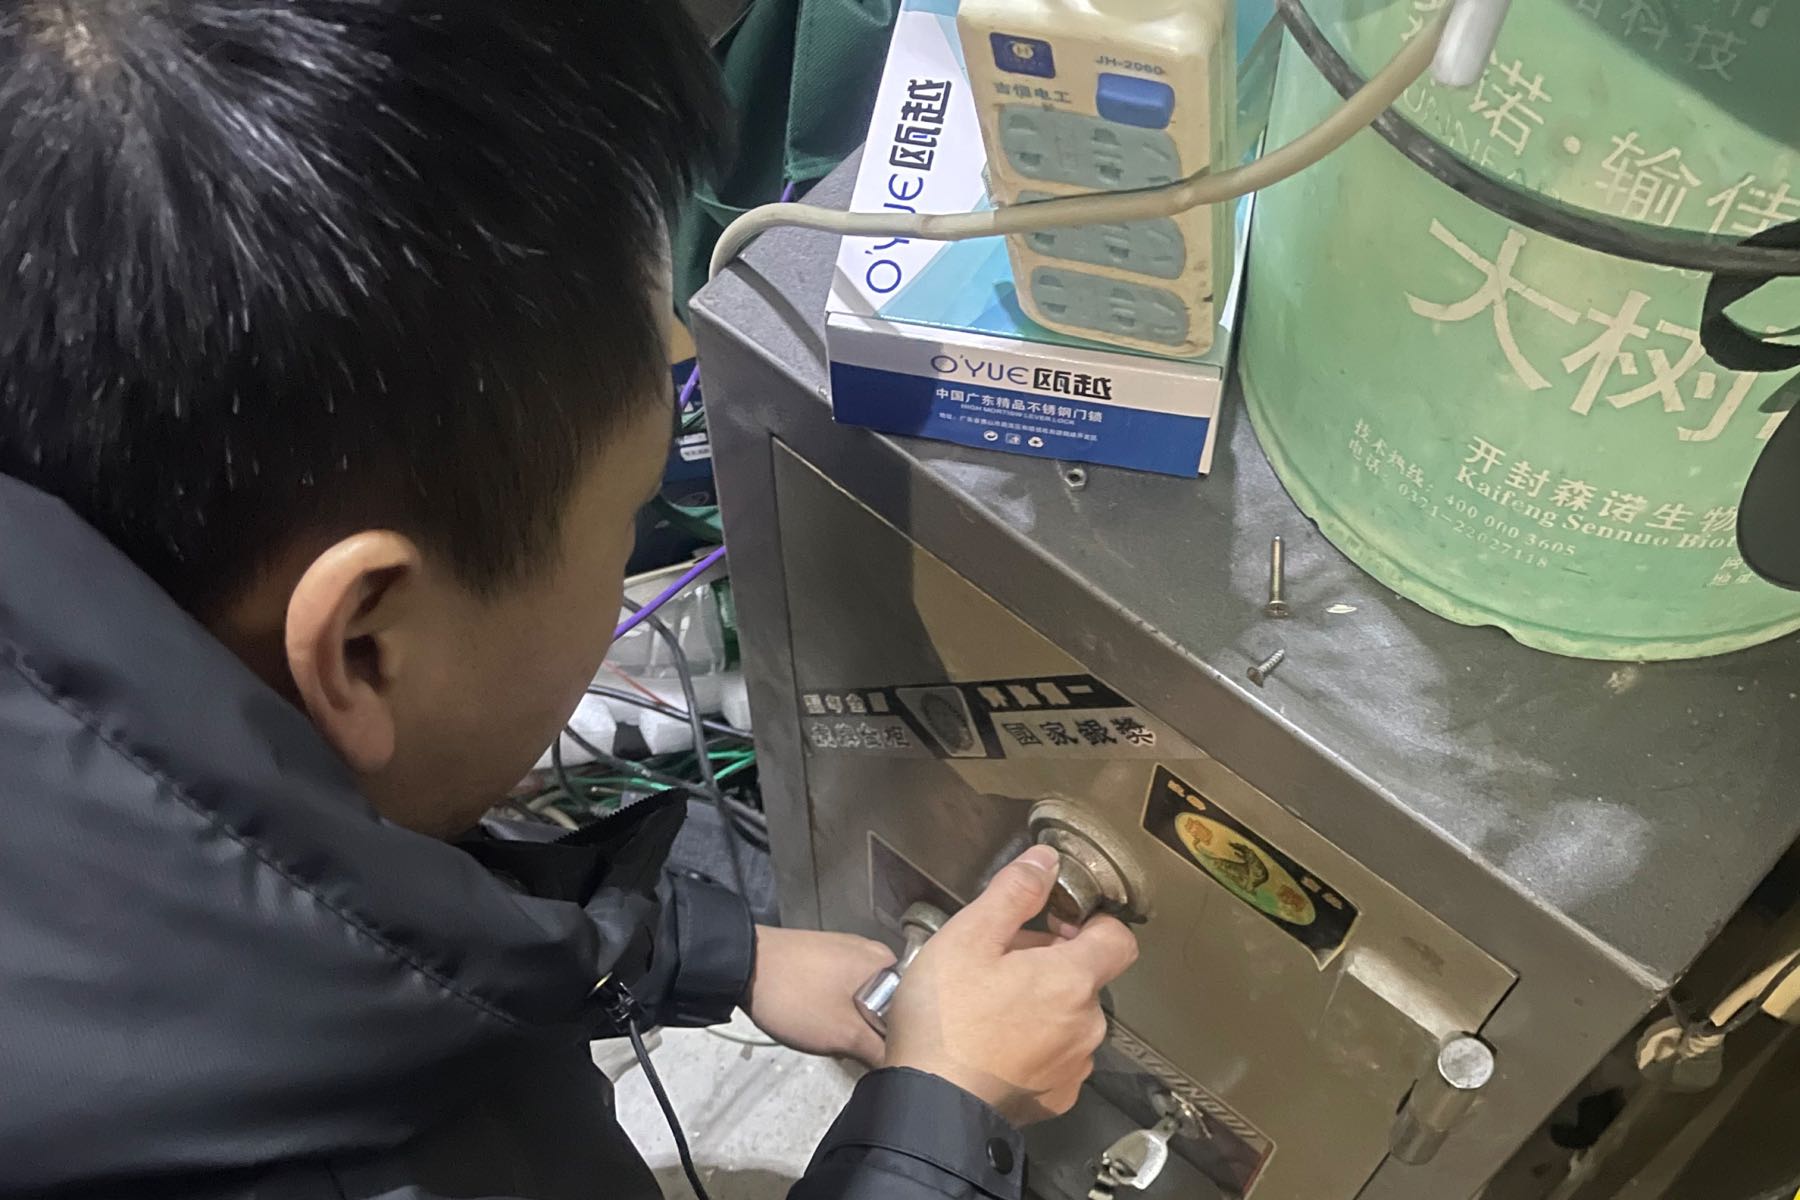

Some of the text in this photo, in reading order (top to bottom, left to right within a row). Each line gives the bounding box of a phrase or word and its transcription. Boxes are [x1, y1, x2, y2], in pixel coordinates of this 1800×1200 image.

[936, 387, 1103, 423] 中国广东精品不锈钢门锁
[1455, 464, 1559, 529] Kaifeng
[1562, 513, 1670, 546] Sennuo
